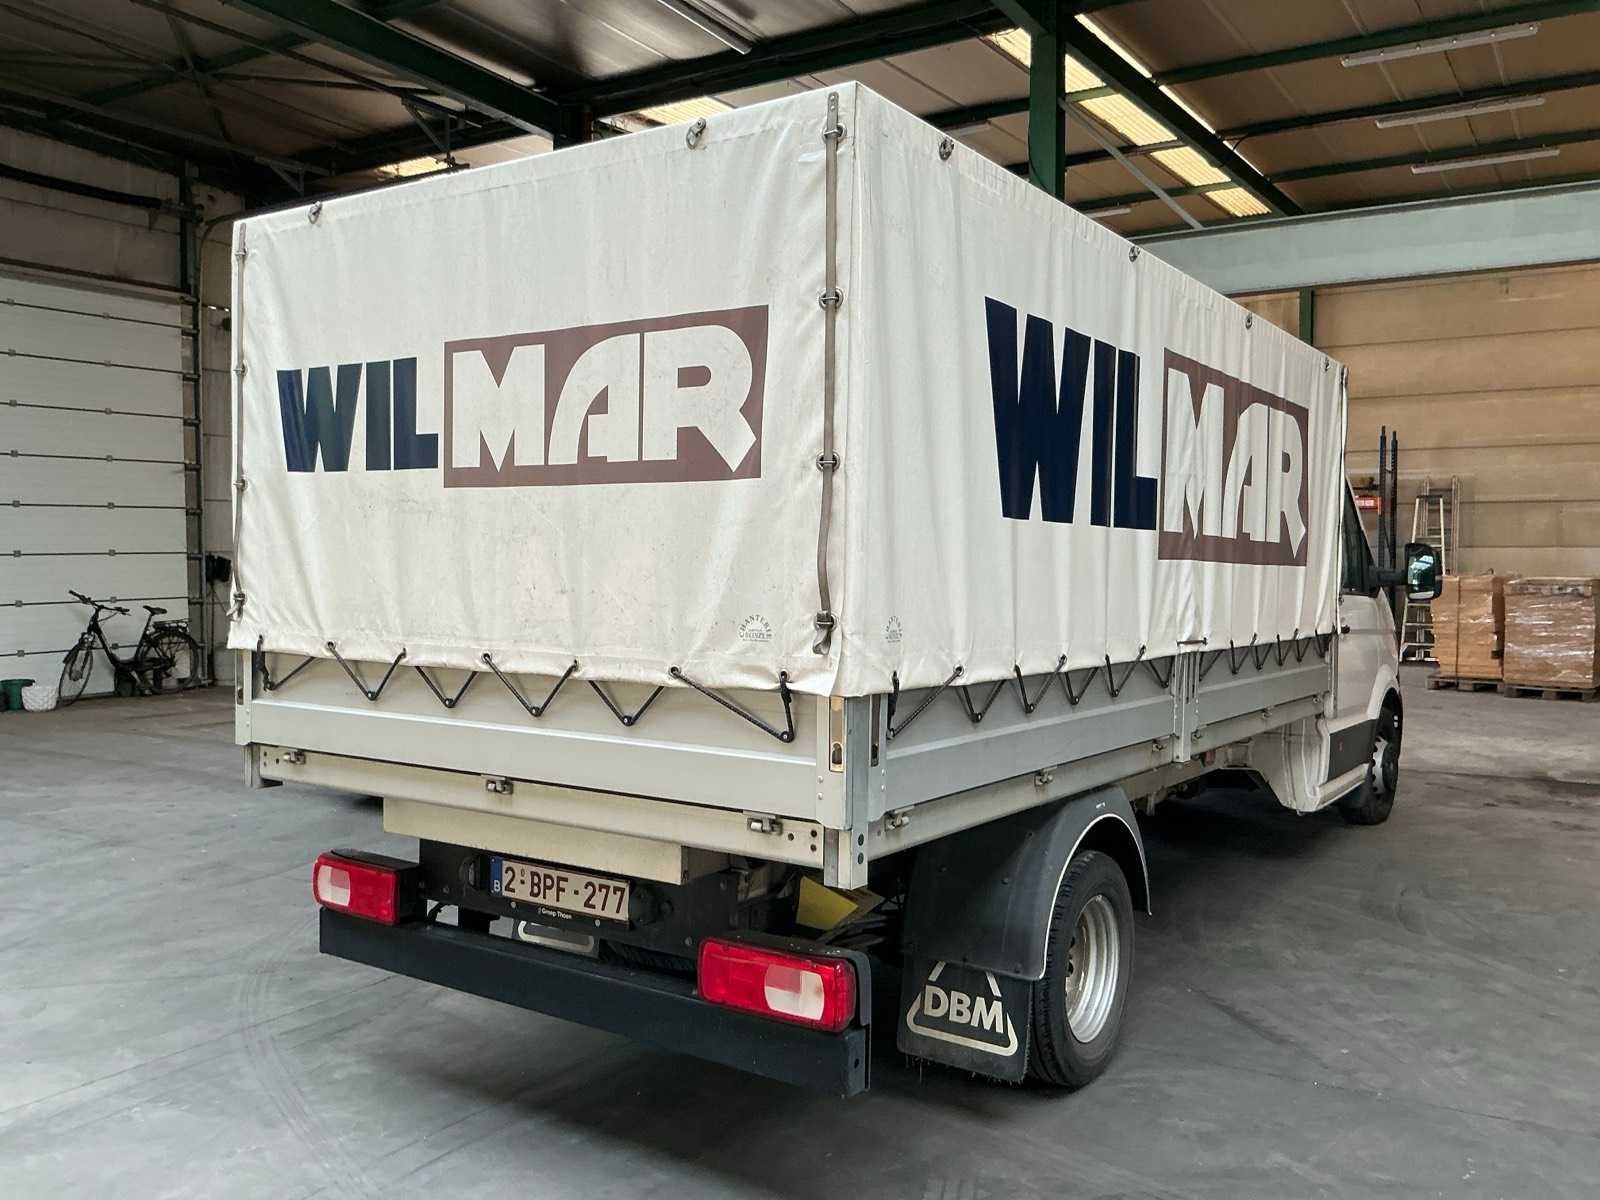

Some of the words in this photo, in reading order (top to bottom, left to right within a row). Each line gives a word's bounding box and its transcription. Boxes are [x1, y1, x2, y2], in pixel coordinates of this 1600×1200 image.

[277, 324, 757, 472] WILMAR
[985, 296, 1306, 559] WILMAR
[494, 880, 501, 892] B
[924, 984, 1004, 1034] DBM
